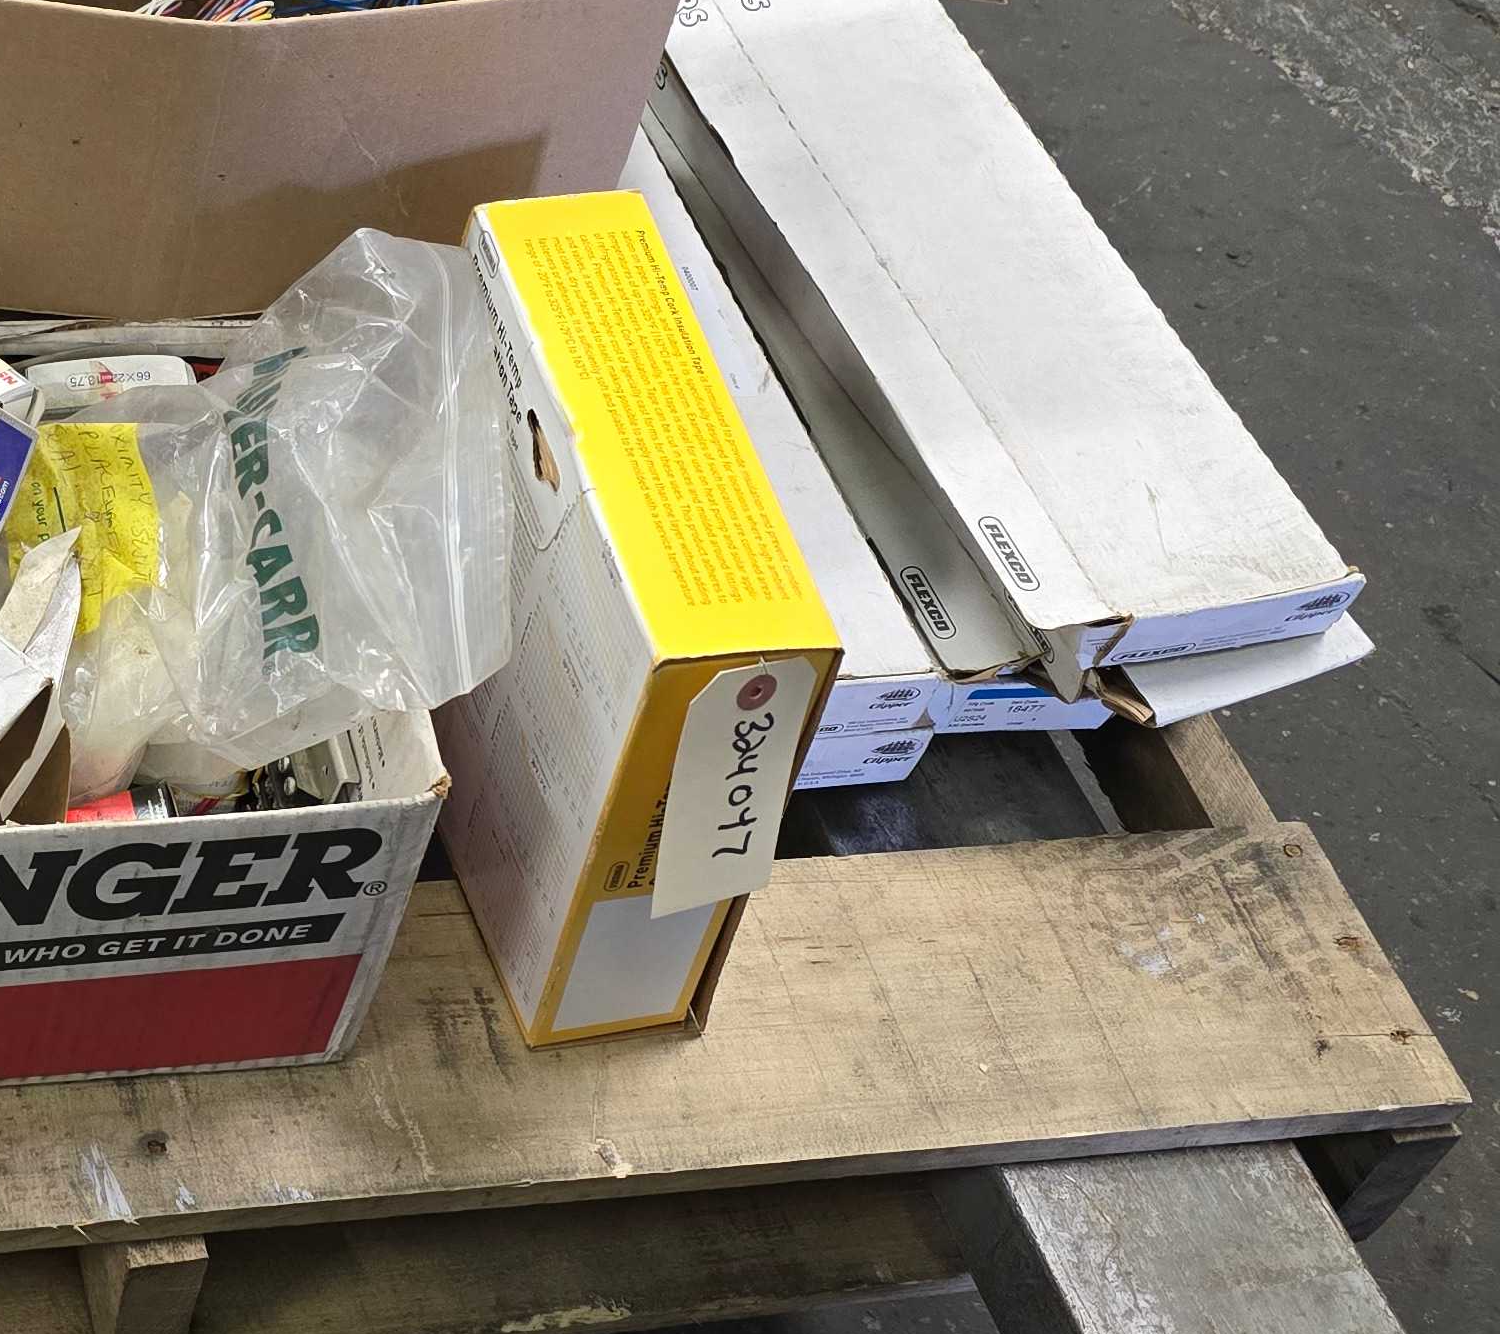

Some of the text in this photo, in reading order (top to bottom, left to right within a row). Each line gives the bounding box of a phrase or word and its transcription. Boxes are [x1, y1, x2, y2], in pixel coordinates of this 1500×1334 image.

[473, 254, 523, 389] Premium Hi-Temp
[637, 230, 657, 262] Premium
[650, 264, 672, 295] Hi-Temp
[666, 297, 680, 314] Cork
[675, 317, 697, 354] Insulation
[690, 357, 706, 374] Tape
[32, 499, 48, 527] your
[984, 523, 1034, 584] FLEXCO
[905, 573, 950, 632] FLEXCO
[627, 828, 660, 889] Premium
[4, 943, 86, 964] WHO
[97, 937, 166, 956] GET
[172, 933, 206, 950] IT
[213, 923, 312, 947] DONE
